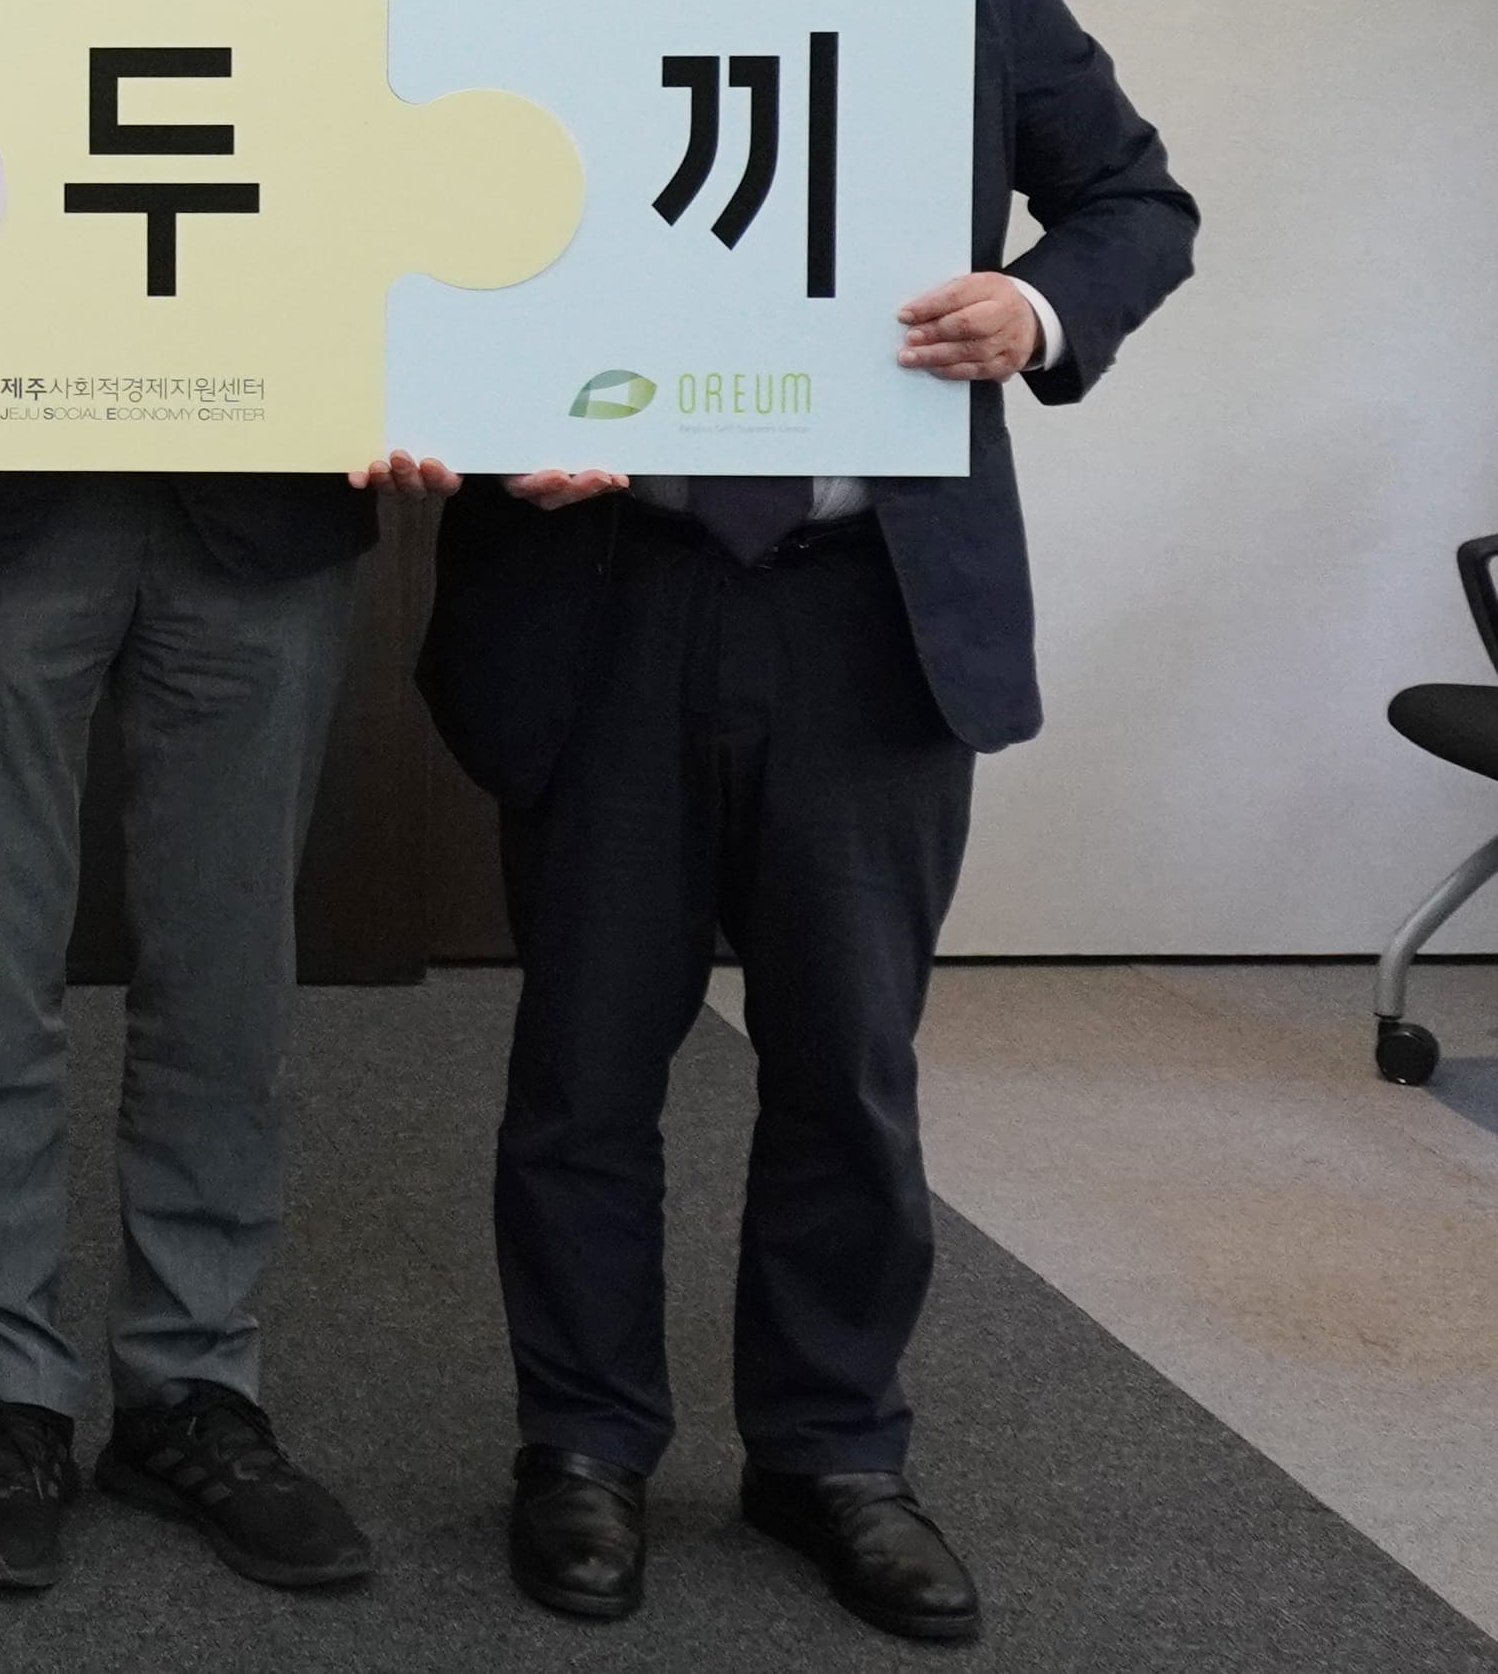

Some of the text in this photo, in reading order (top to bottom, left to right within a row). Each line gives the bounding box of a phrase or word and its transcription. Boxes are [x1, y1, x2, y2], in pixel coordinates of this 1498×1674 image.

[63, 46, 262, 299] 두
[651, 31, 840, 300] 끼
[0, 376, 266, 403] 제주사회적경제지원센터
[678, 372, 812, 415] OREUM
[0, 407, 266, 422] JEJU SOCIAL ECONOMY CENTER
